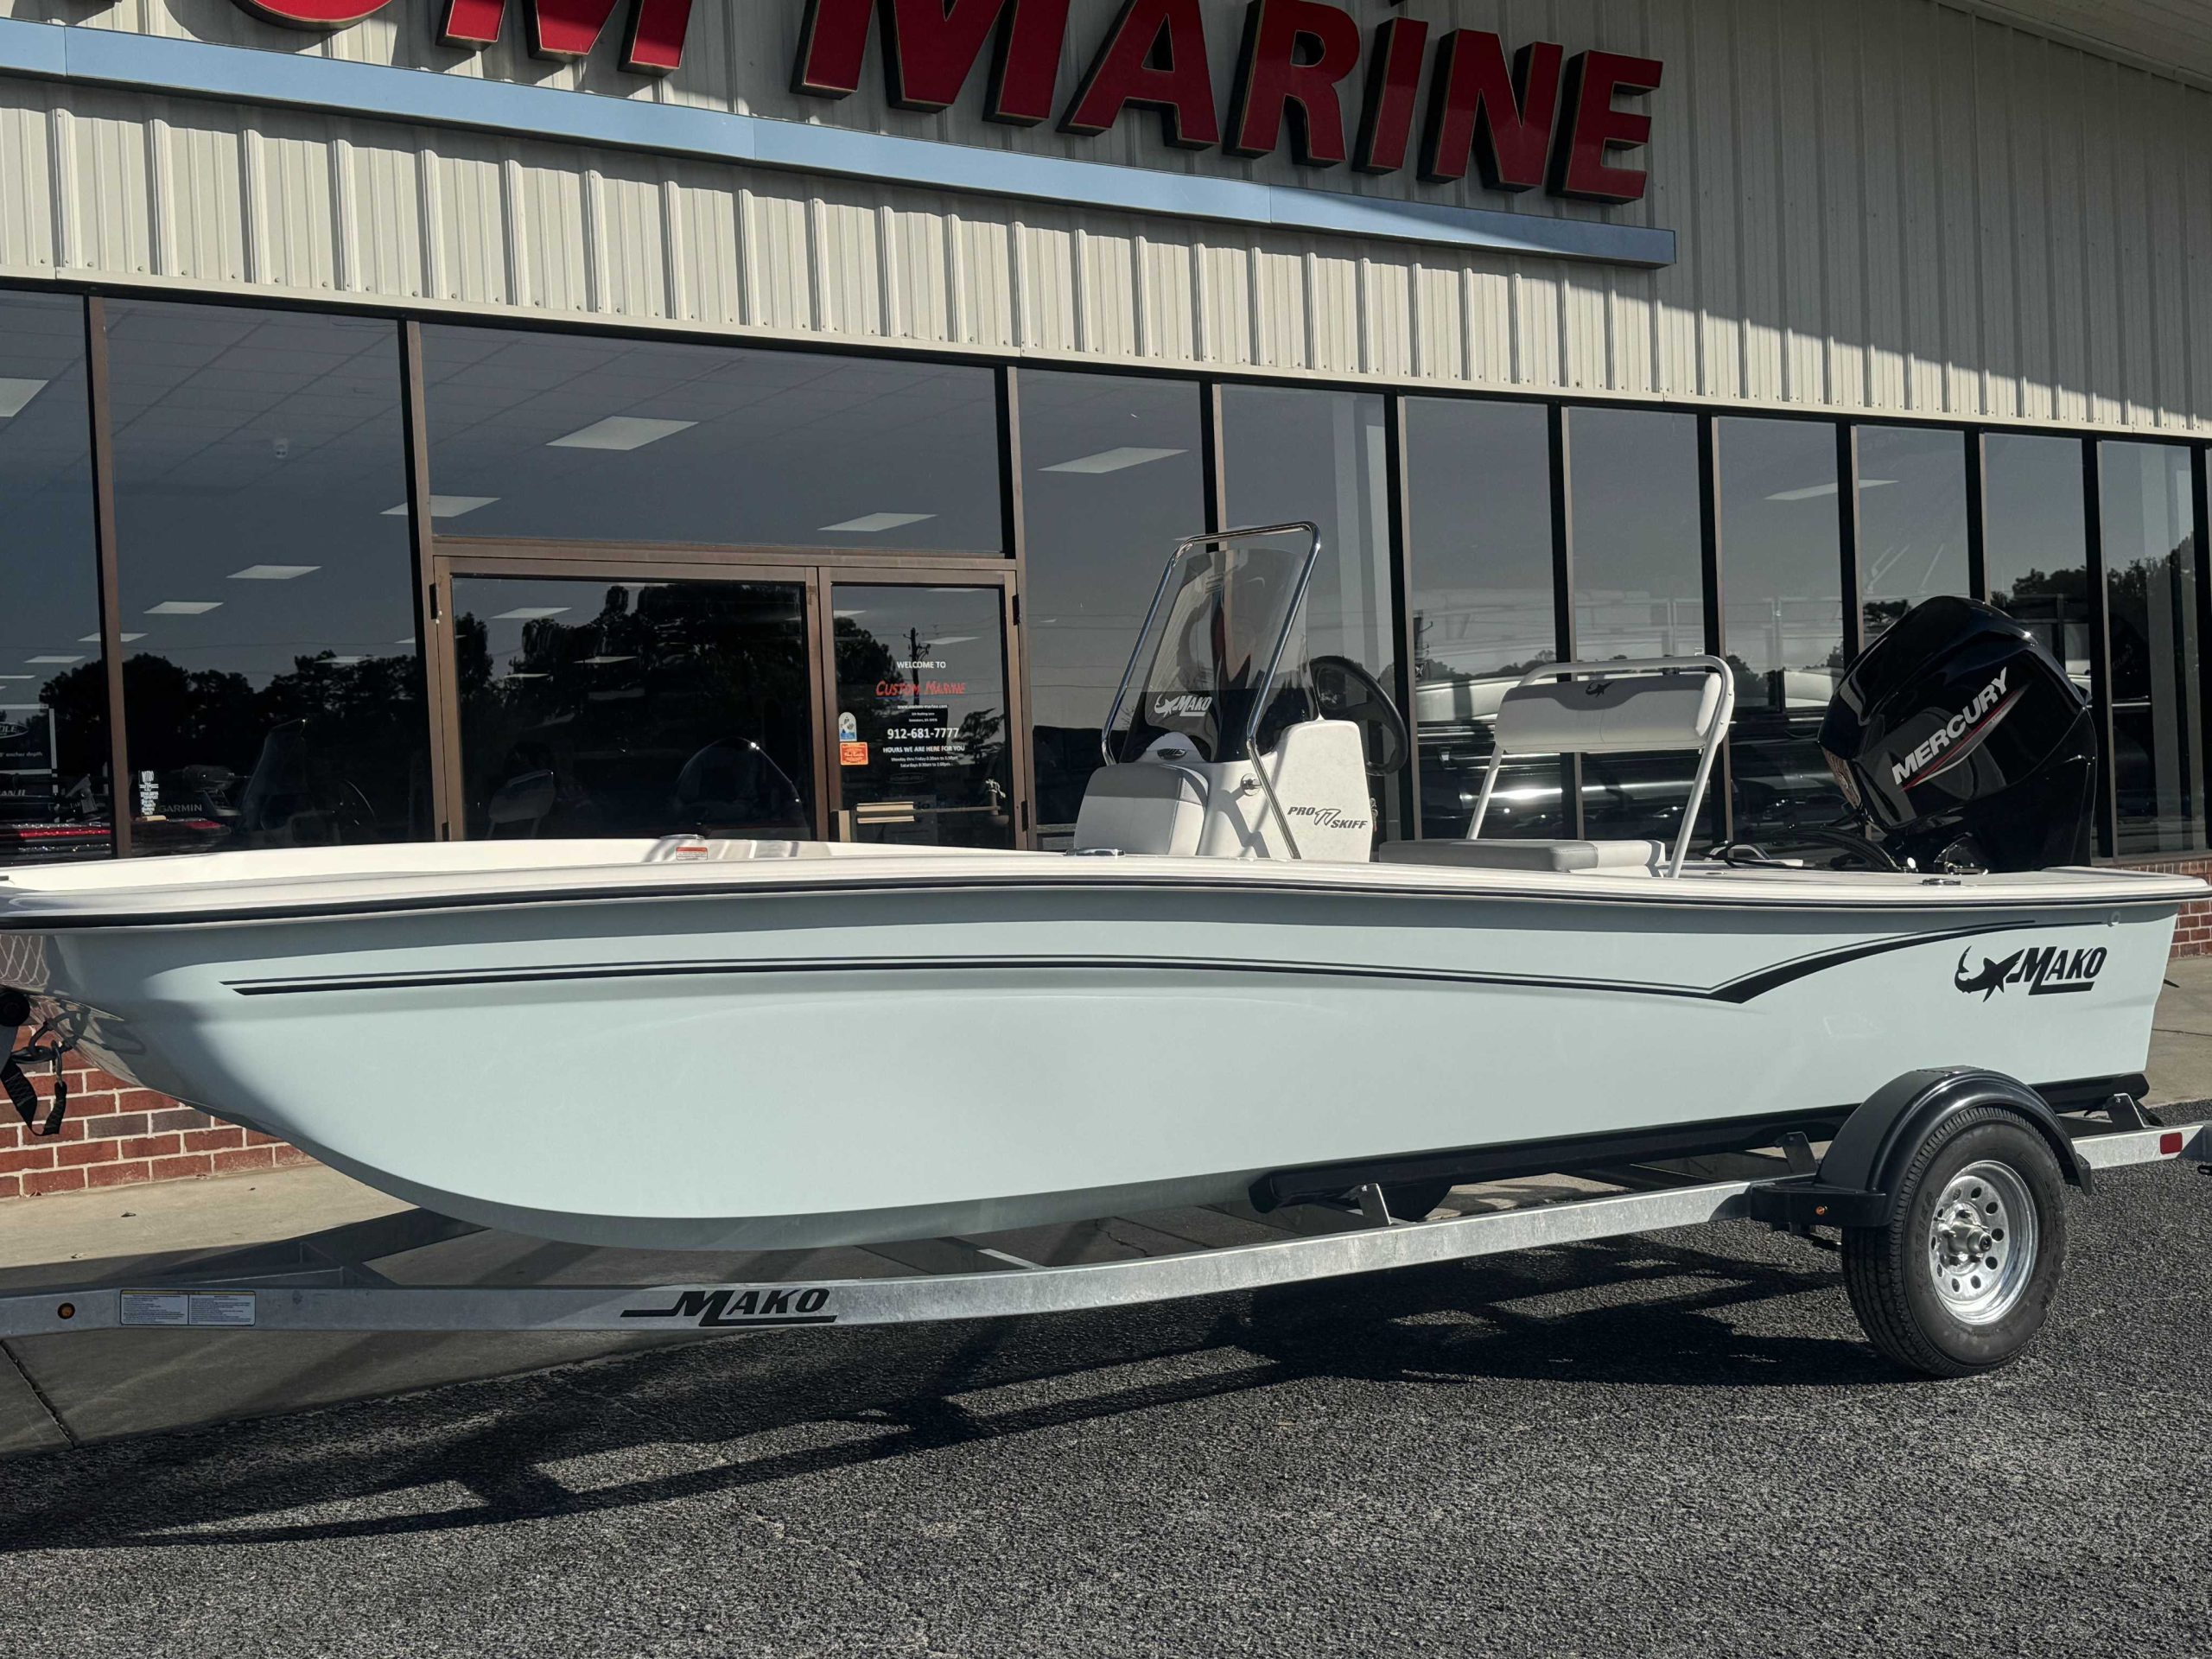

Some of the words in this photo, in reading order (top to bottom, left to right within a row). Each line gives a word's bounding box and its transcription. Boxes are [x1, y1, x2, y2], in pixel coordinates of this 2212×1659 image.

[792, 0, 1662, 203] MARINE
[875, 680, 920, 696] CUSTOM
[924, 680, 966, 695] MARINE
[1172, 695, 1213, 716] MAKO
[887, 728, 959, 739] 912-681-7777
[1891, 666, 2007, 785] MERCURY
[159, 804, 202, 813] GARMIN
[1287, 806, 1316, 816] PRO
[1313, 808, 1342, 826] 17
[1330, 819, 1369, 829] SKIFF
[2005, 945, 2107, 995] MAKO
[620, 1287, 838, 1327] MAKO
